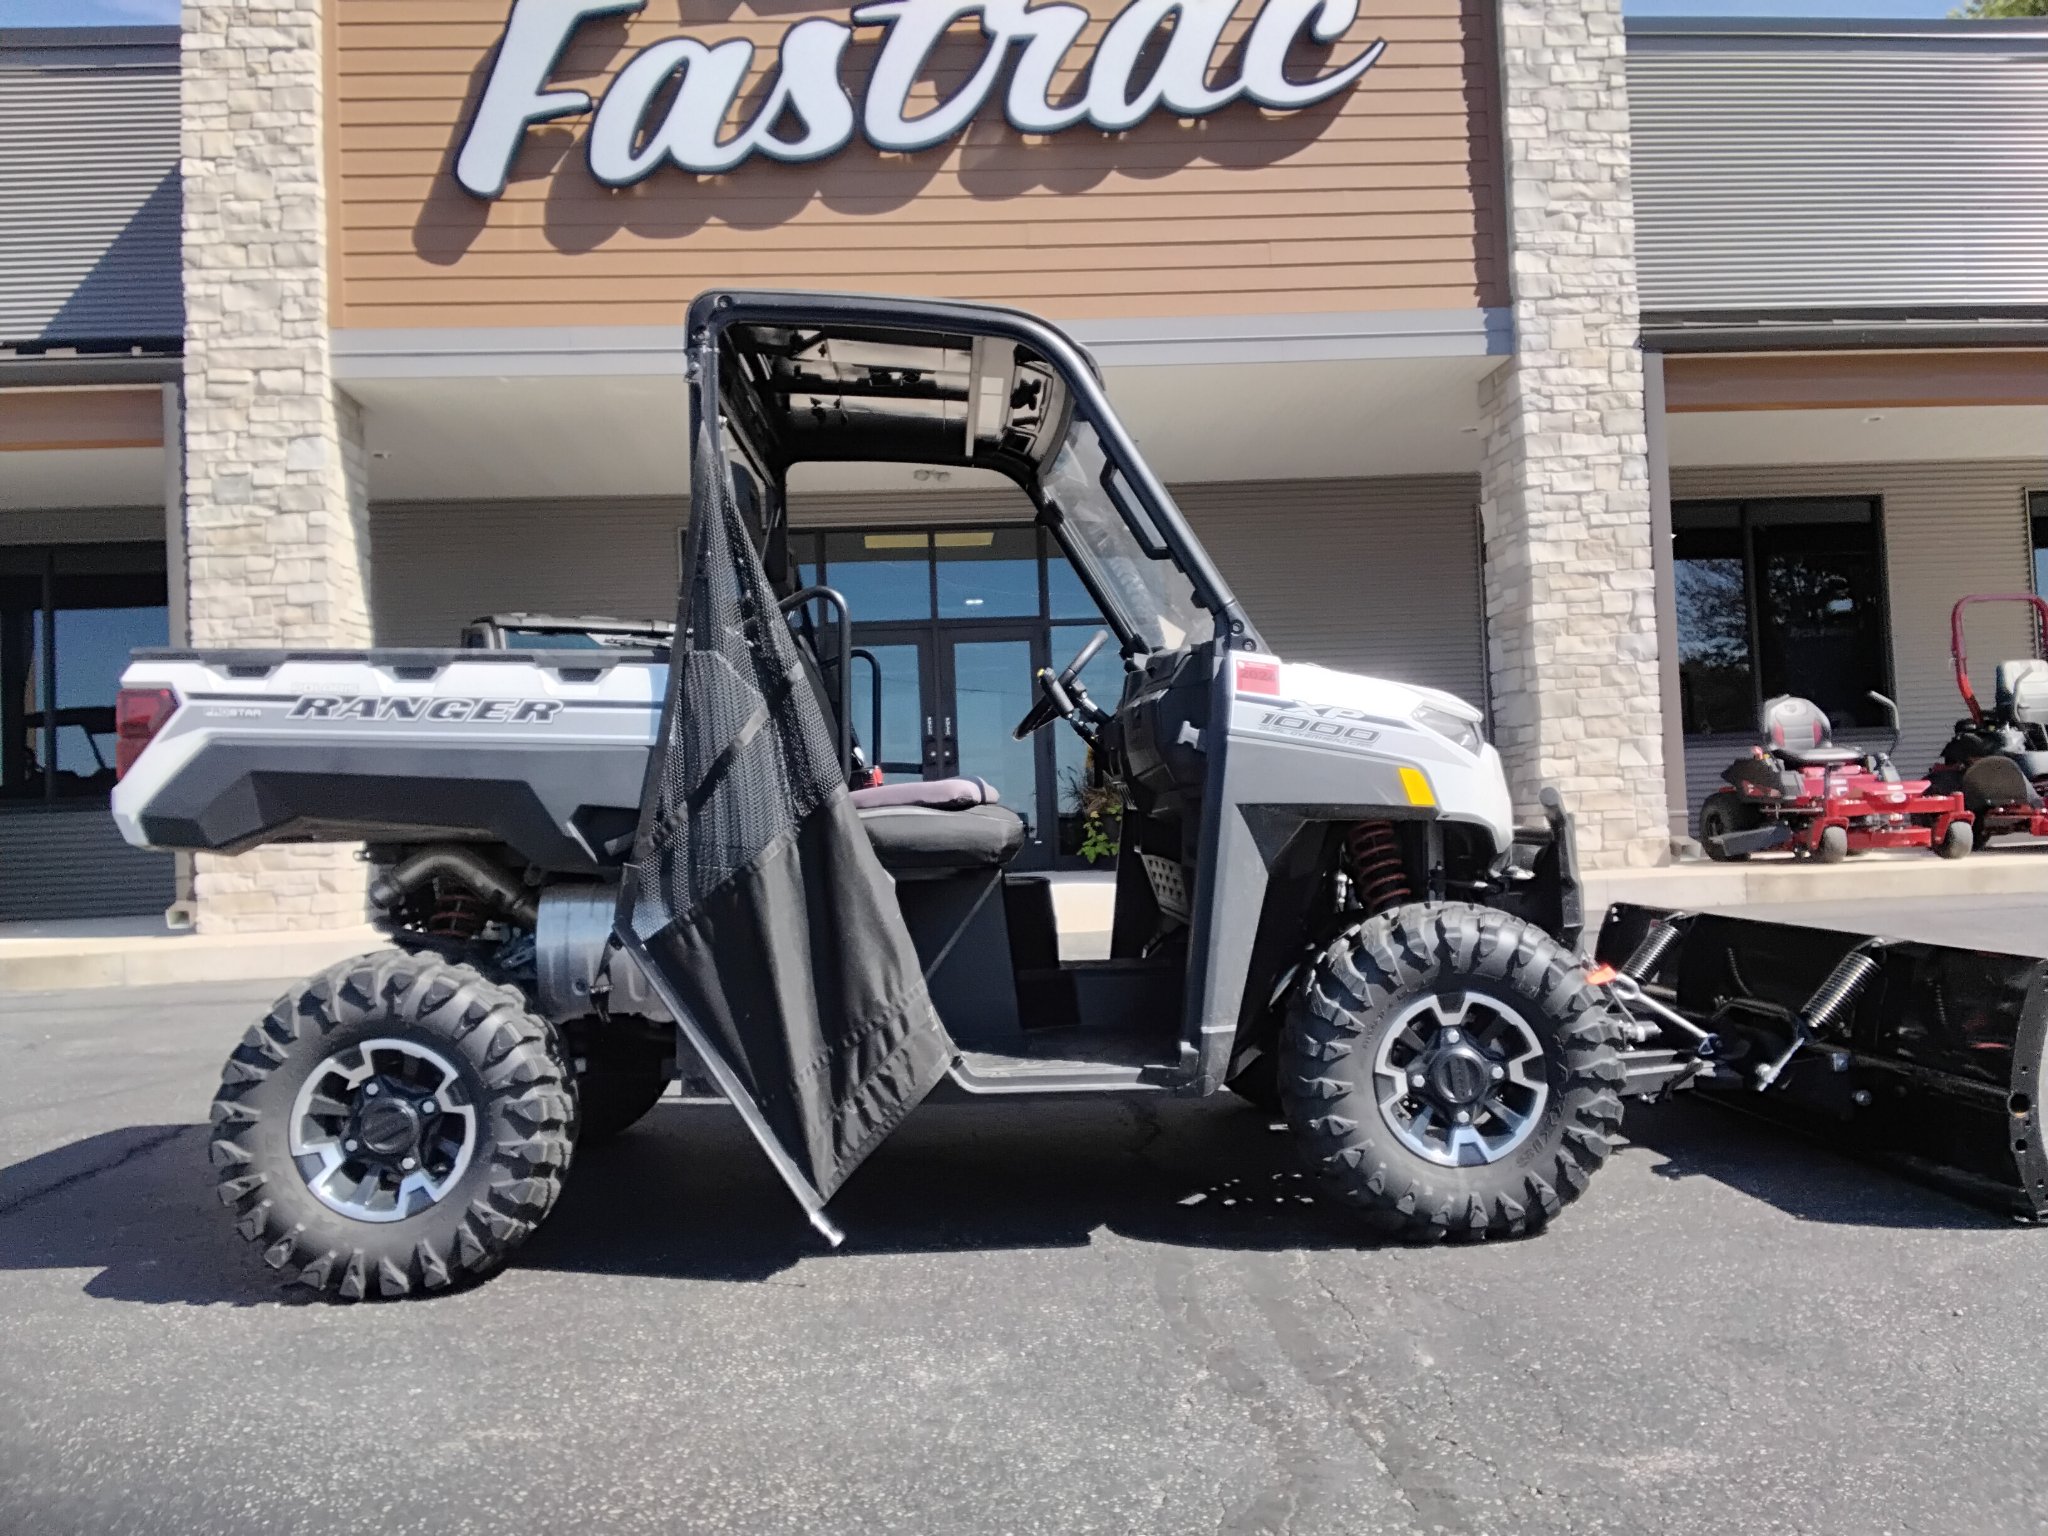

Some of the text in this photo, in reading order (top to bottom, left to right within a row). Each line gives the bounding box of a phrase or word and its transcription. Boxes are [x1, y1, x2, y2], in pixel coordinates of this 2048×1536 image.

[453, 0, 1387, 197] Fastrac
[286, 695, 563, 723] RANGER
[1283, 699, 1366, 719] XP
[1259, 712, 1381, 742] 1000
